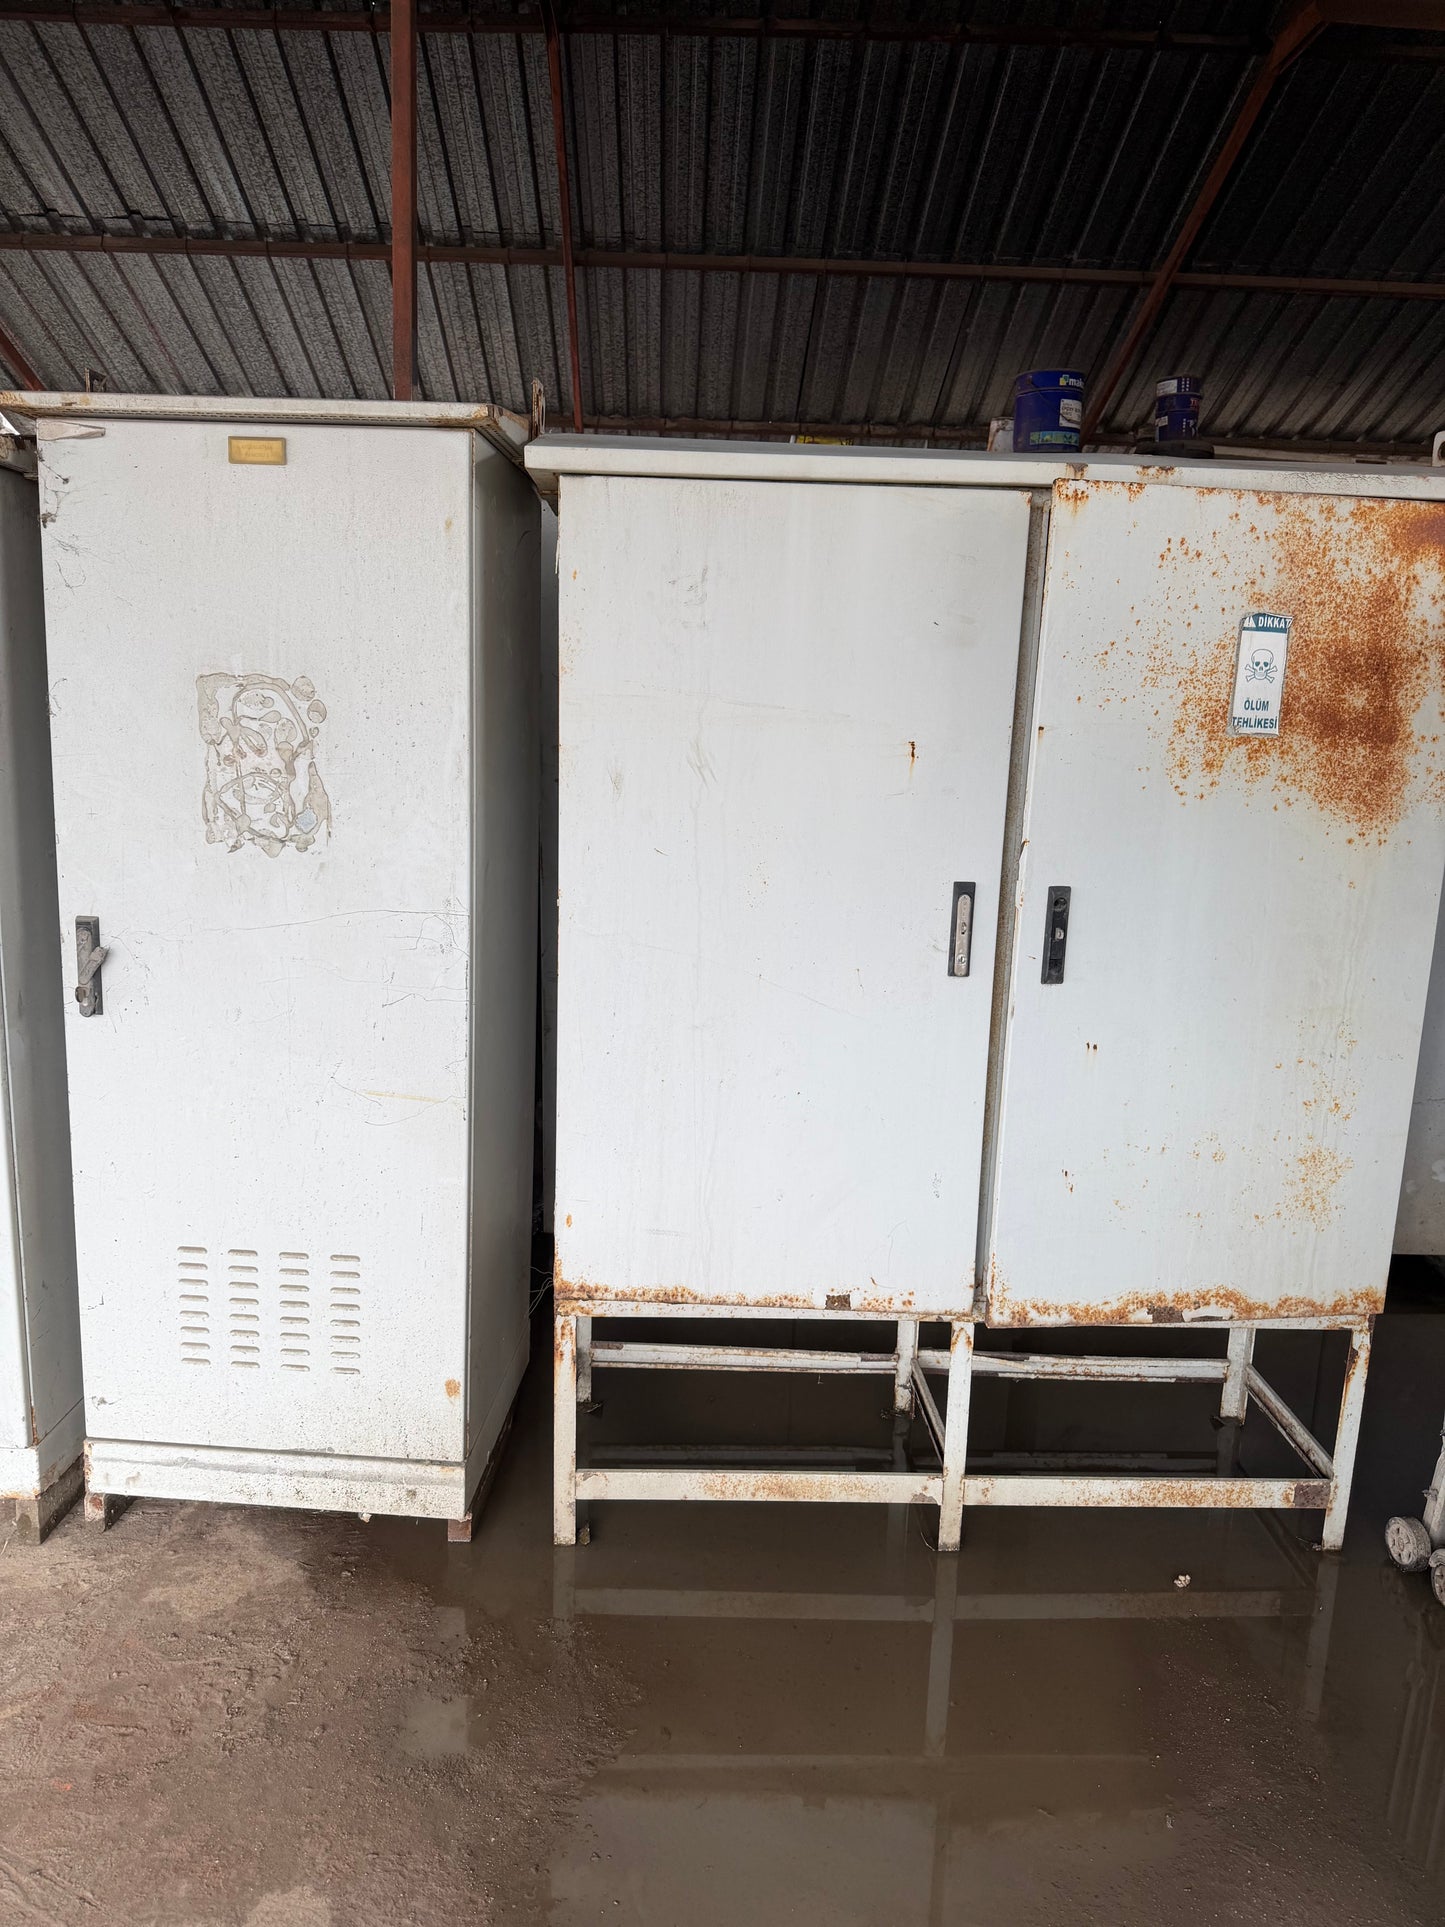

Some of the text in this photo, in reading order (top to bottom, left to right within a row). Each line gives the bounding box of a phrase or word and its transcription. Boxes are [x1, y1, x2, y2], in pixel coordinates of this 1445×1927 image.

[1258, 615, 1291, 629] DİKKAT
[1243, 697, 1269, 711] ÖLÜM
[1232, 715, 1278, 729] TEHLİKESİ
